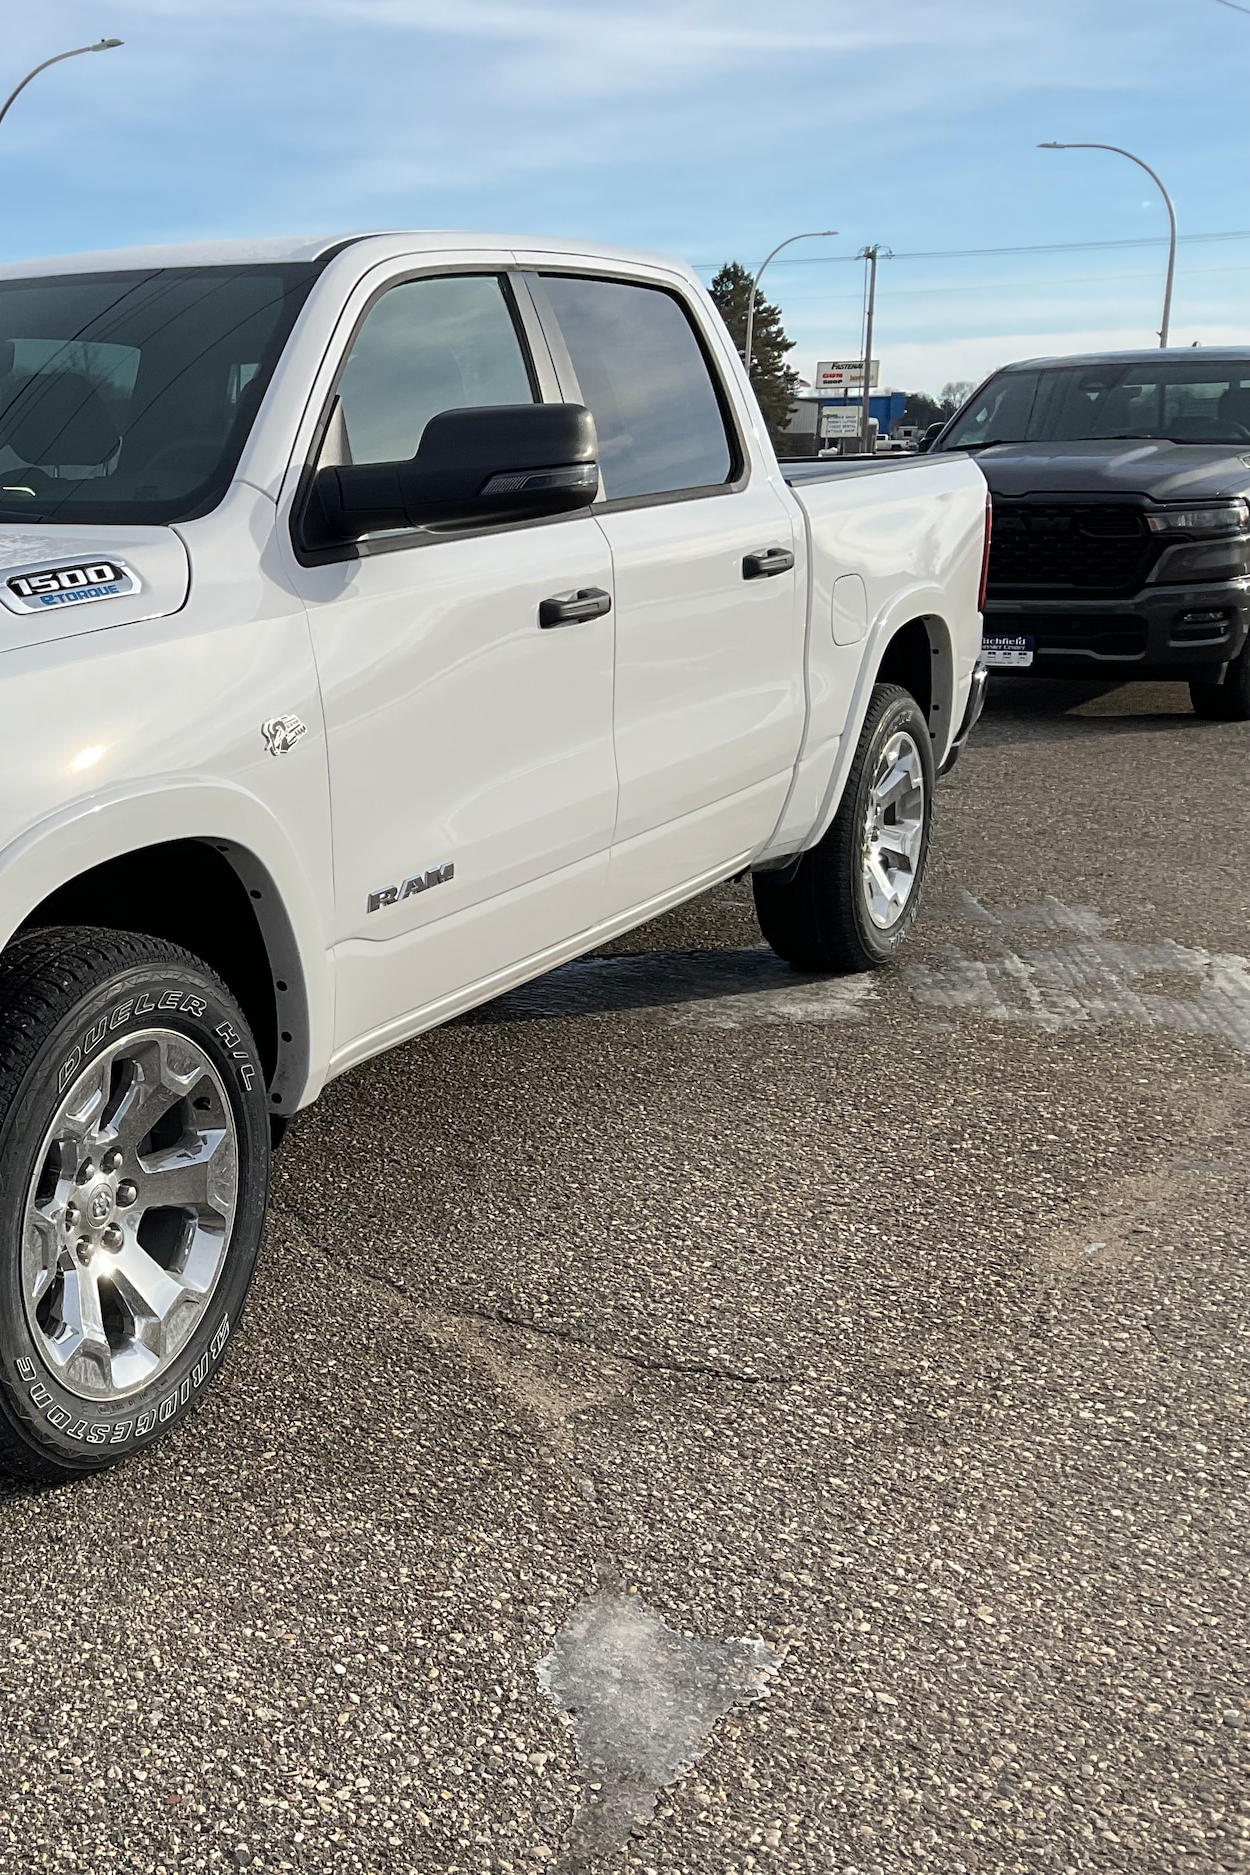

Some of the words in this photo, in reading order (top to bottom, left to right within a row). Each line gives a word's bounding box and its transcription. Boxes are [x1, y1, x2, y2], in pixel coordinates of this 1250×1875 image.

[995, 516, 1071, 531] AM
[11, 564, 116, 595] 1500
[982, 637, 1026, 645] itchfield
[366, 861, 455, 914] RAM
[57, 989, 208, 1094] DUELER
[215, 1020, 257, 1091] H/L
[14, 1311, 230, 1446] BRIDGESTONE
